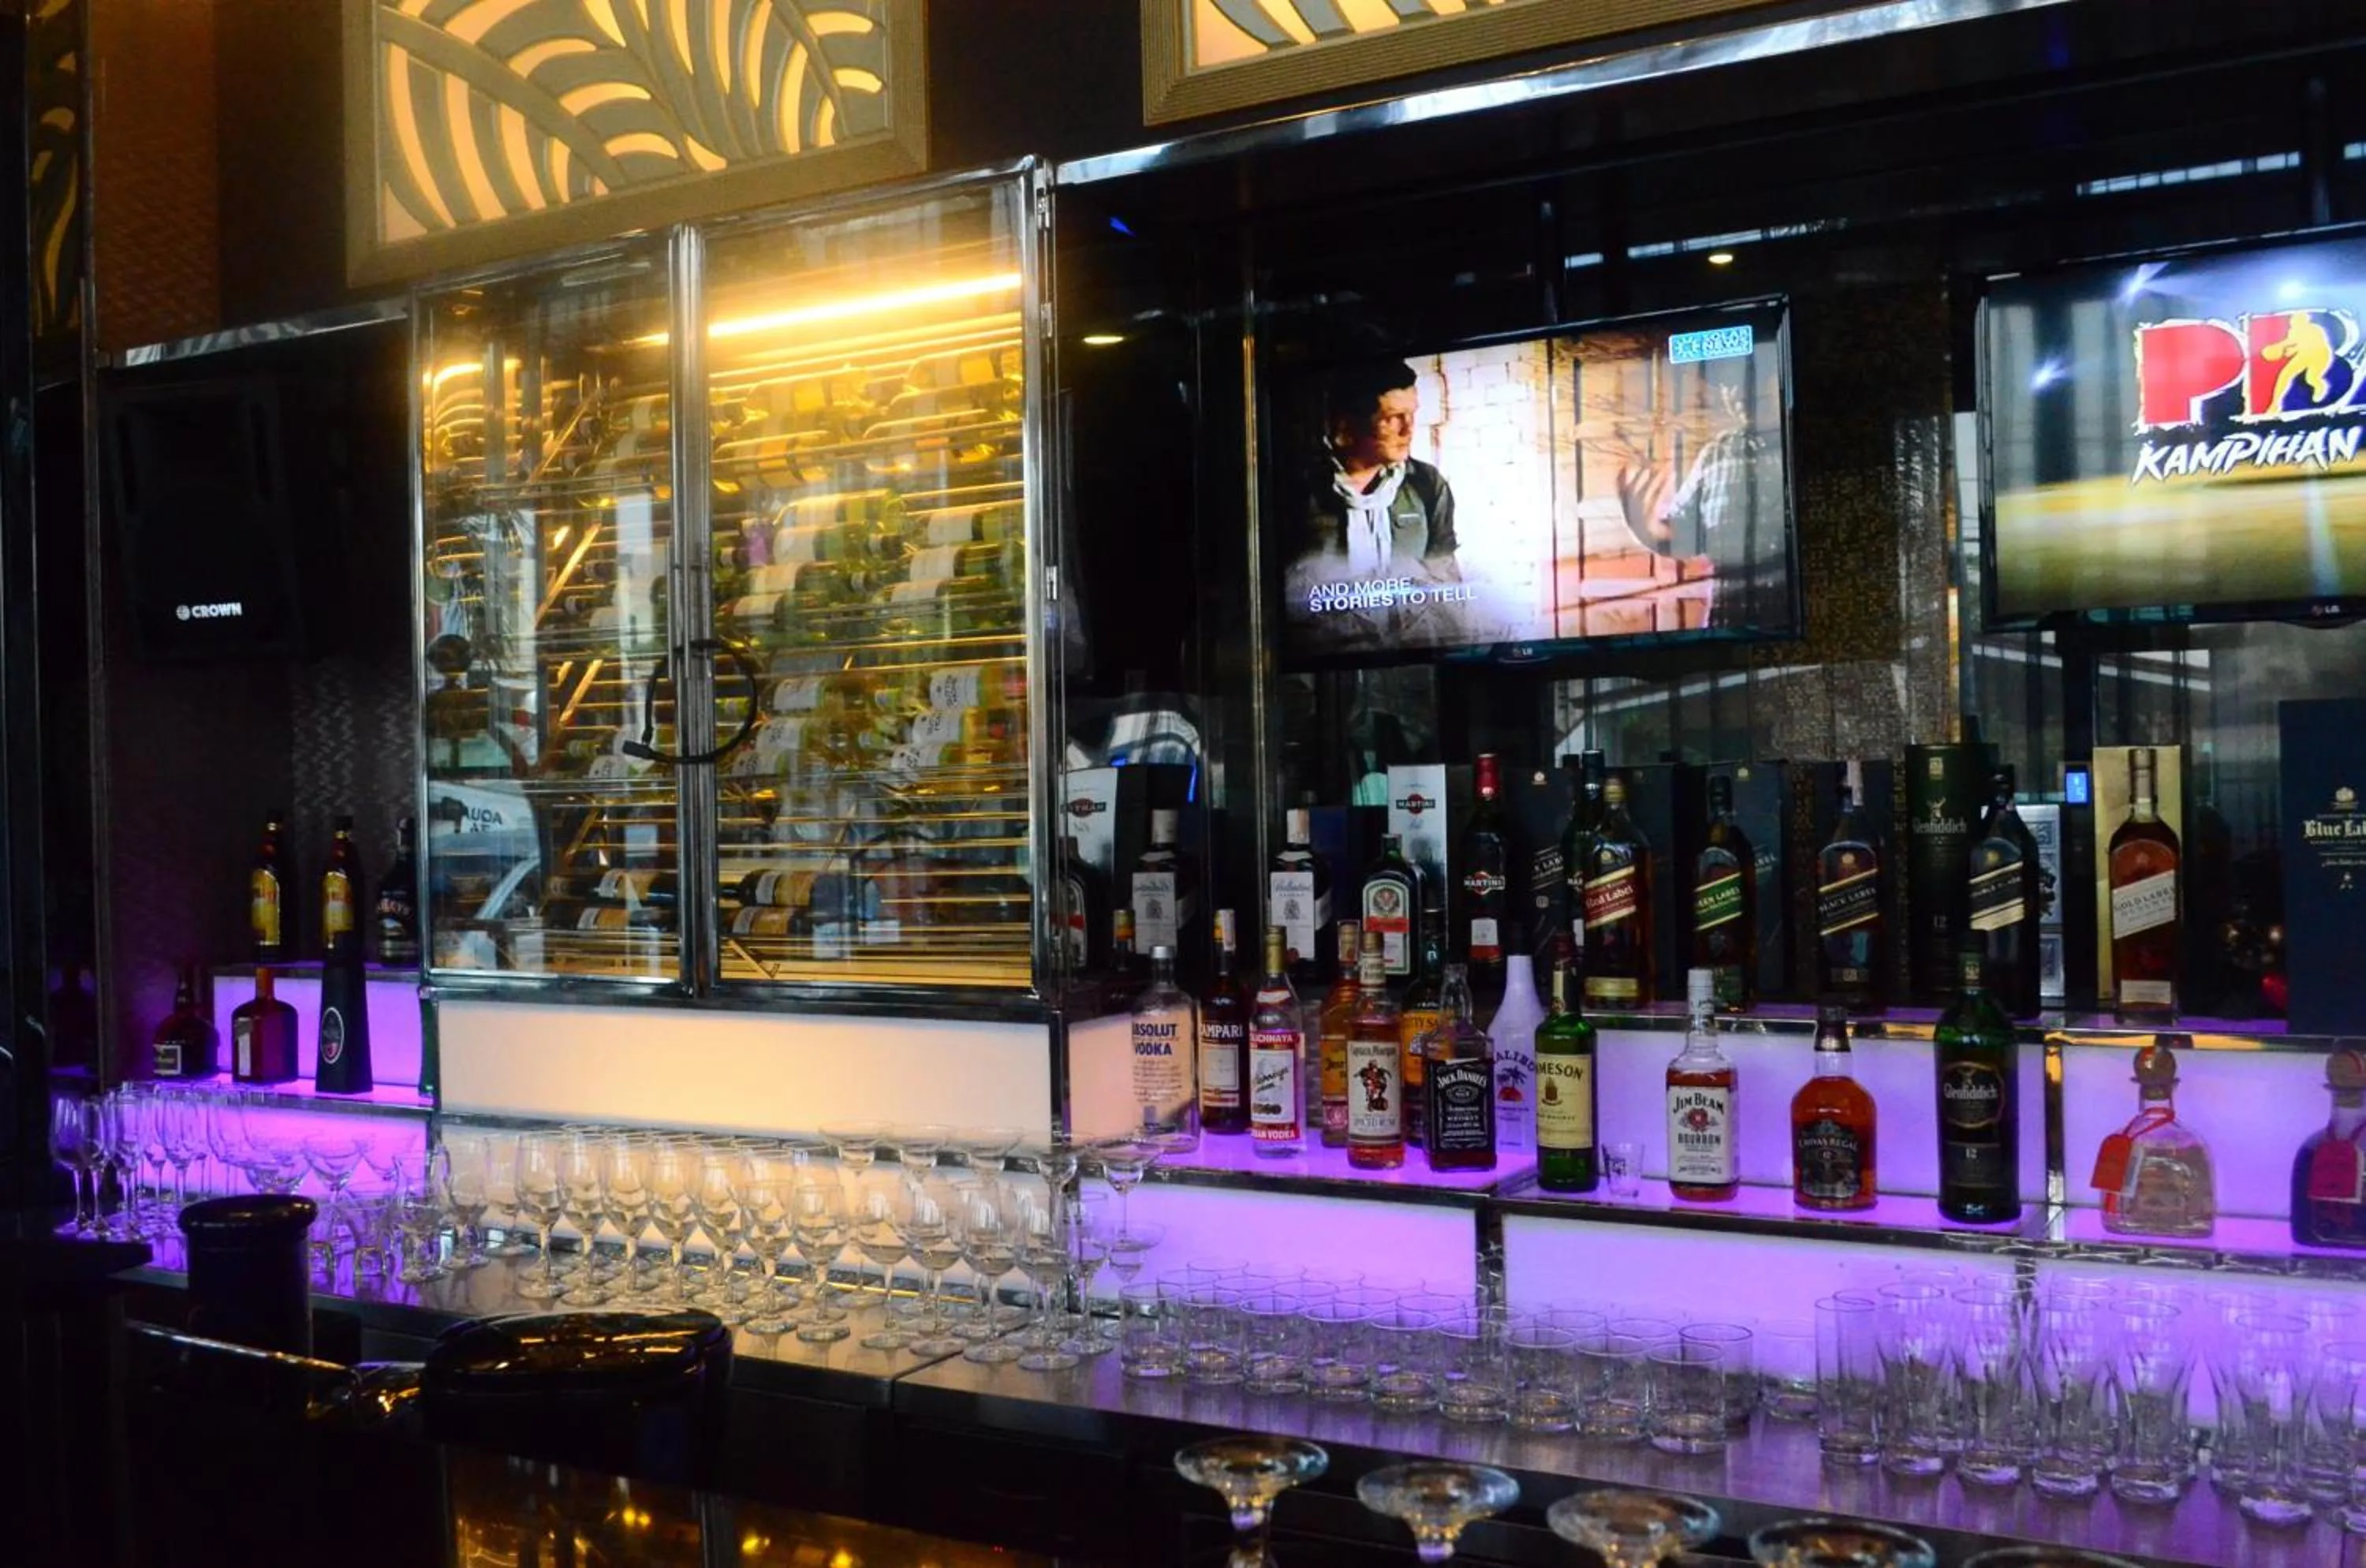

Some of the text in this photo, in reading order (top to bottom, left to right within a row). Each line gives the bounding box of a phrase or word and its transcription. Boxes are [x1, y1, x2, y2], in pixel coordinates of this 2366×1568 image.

[2132, 426, 2363, 483] KAMPIHAN
[1308, 577, 1411, 599] AND MORE
[192, 602, 242, 618] CROWN
[1310, 586, 1477, 613] STORIES TO TELL
[2303, 819, 2342, 838] Blue
[1135, 1041, 1172, 1055] VODKA
[1537, 1061, 1583, 1081] MESON
[1672, 1092, 1725, 1114] JIM BEAM
